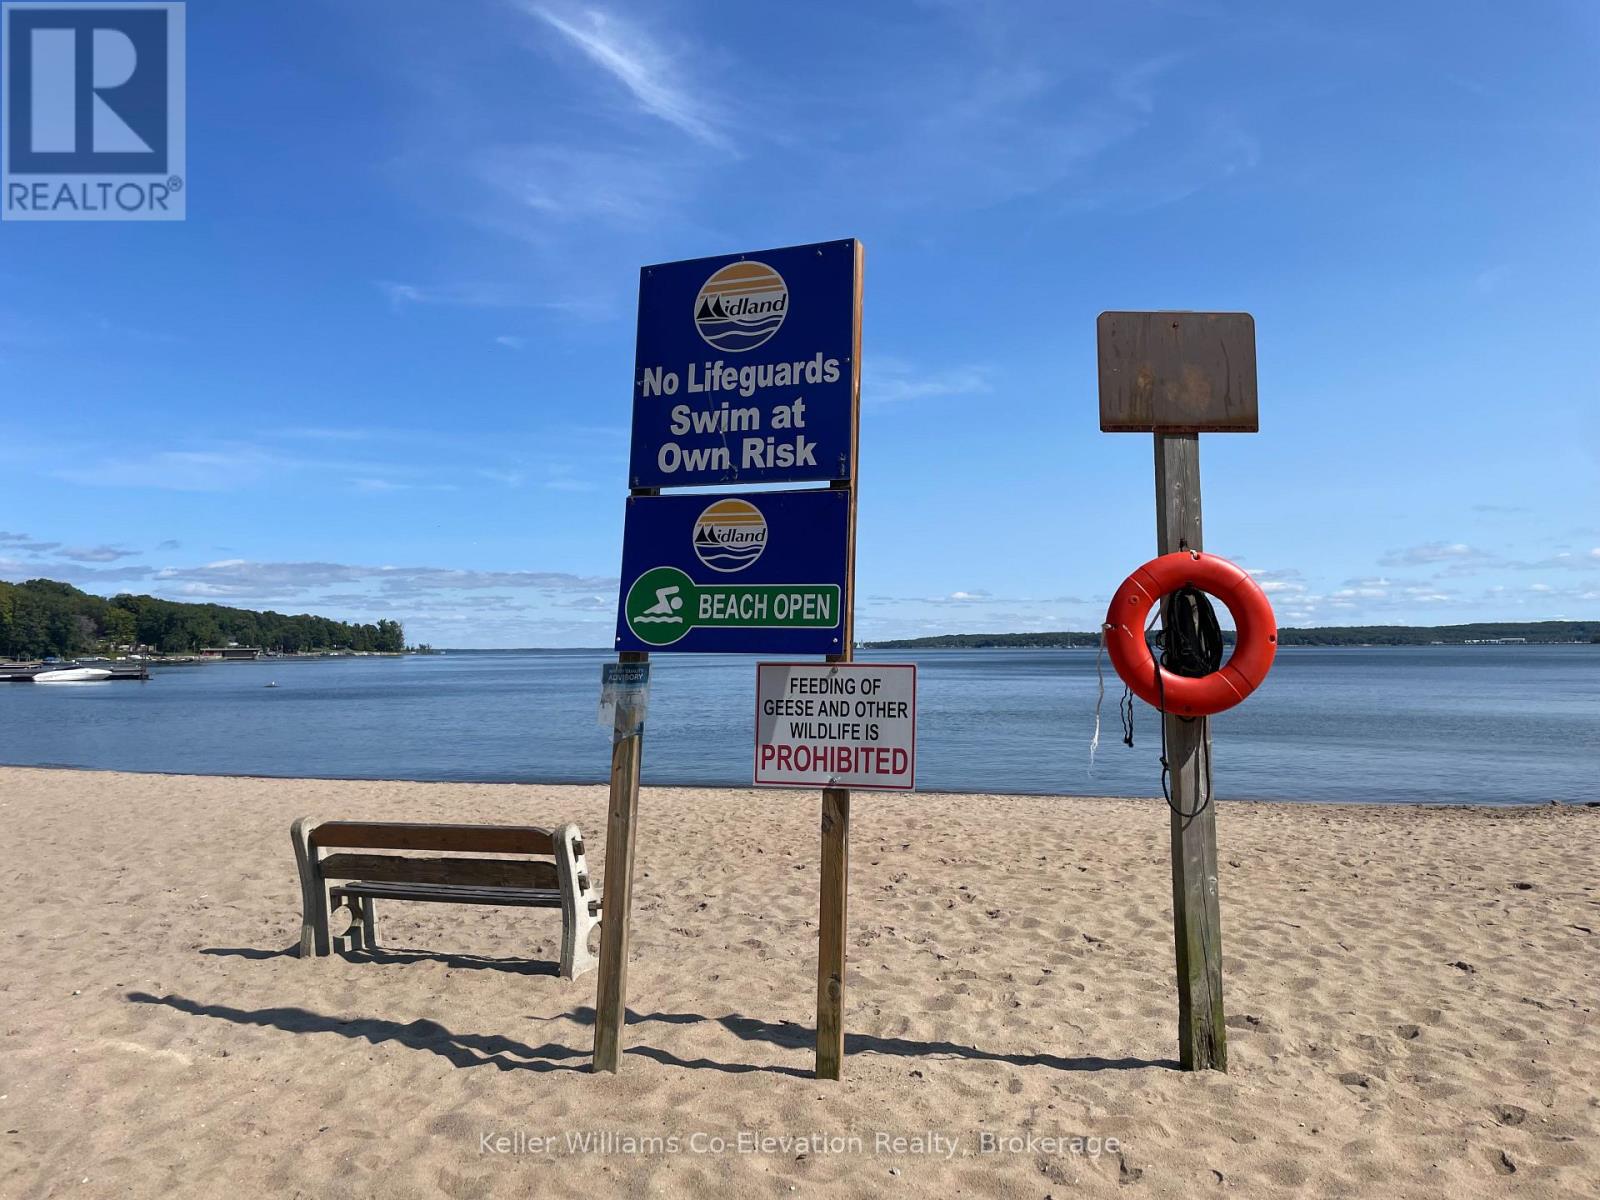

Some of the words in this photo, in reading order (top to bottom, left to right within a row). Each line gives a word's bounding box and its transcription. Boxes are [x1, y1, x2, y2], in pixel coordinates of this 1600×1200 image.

[696, 293, 787, 320] Midland
[642, 366, 679, 397] No
[687, 352, 840, 397] Lifeguards
[670, 402, 760, 435] Swim
[771, 397, 806, 429] at
[658, 442, 730, 473] Own
[741, 435, 818, 469] Risk
[695, 525, 767, 544] Midland
[698, 593, 768, 620] BEACH
[773, 593, 831, 620] OPEN
[608, 673, 644, 681] ADVISORY
[790, 677, 856, 695] FEEDING
[860, 678, 881, 695] OF
[763, 699, 814, 717] GEESE
[818, 700, 850, 717] AND
[855, 701, 908, 719] OTHER
[790, 722, 861, 740] WILDLIFE
[865, 723, 879, 741] IS
[761, 744, 908, 775] PROHIBITED
